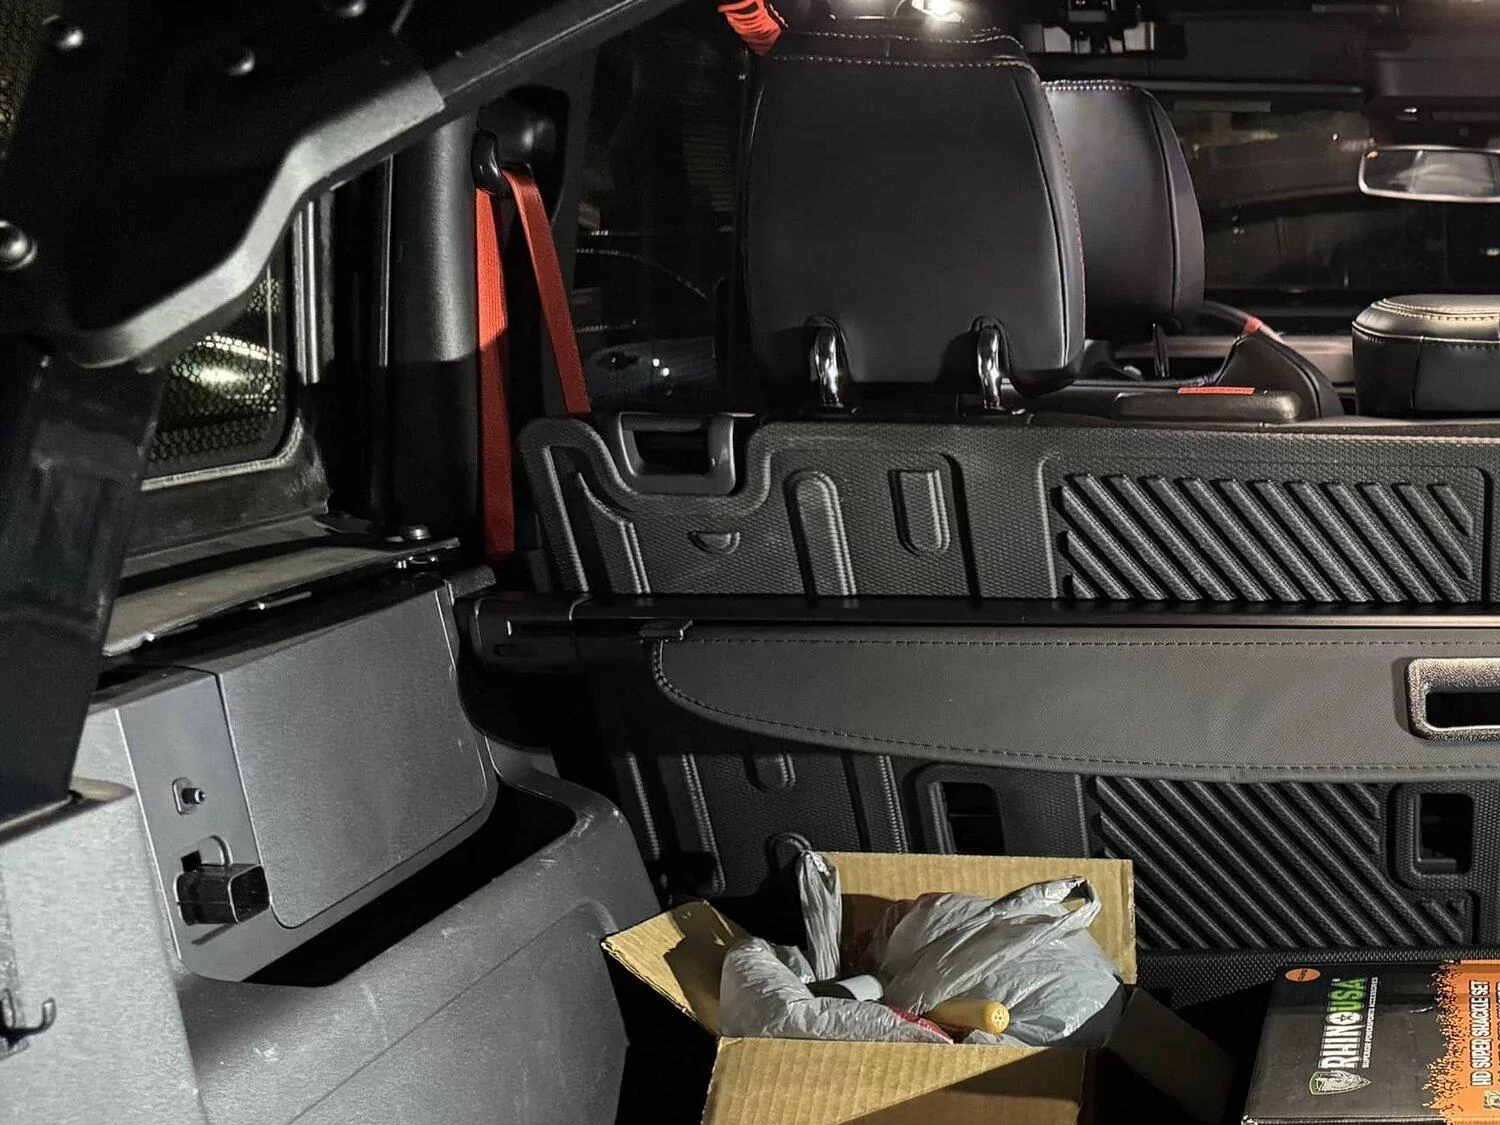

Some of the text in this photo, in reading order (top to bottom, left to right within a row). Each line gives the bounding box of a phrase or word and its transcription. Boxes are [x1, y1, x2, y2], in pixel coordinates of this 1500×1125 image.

[1469, 980, 1492, 1086] HD SUPER SHACKLE SET
